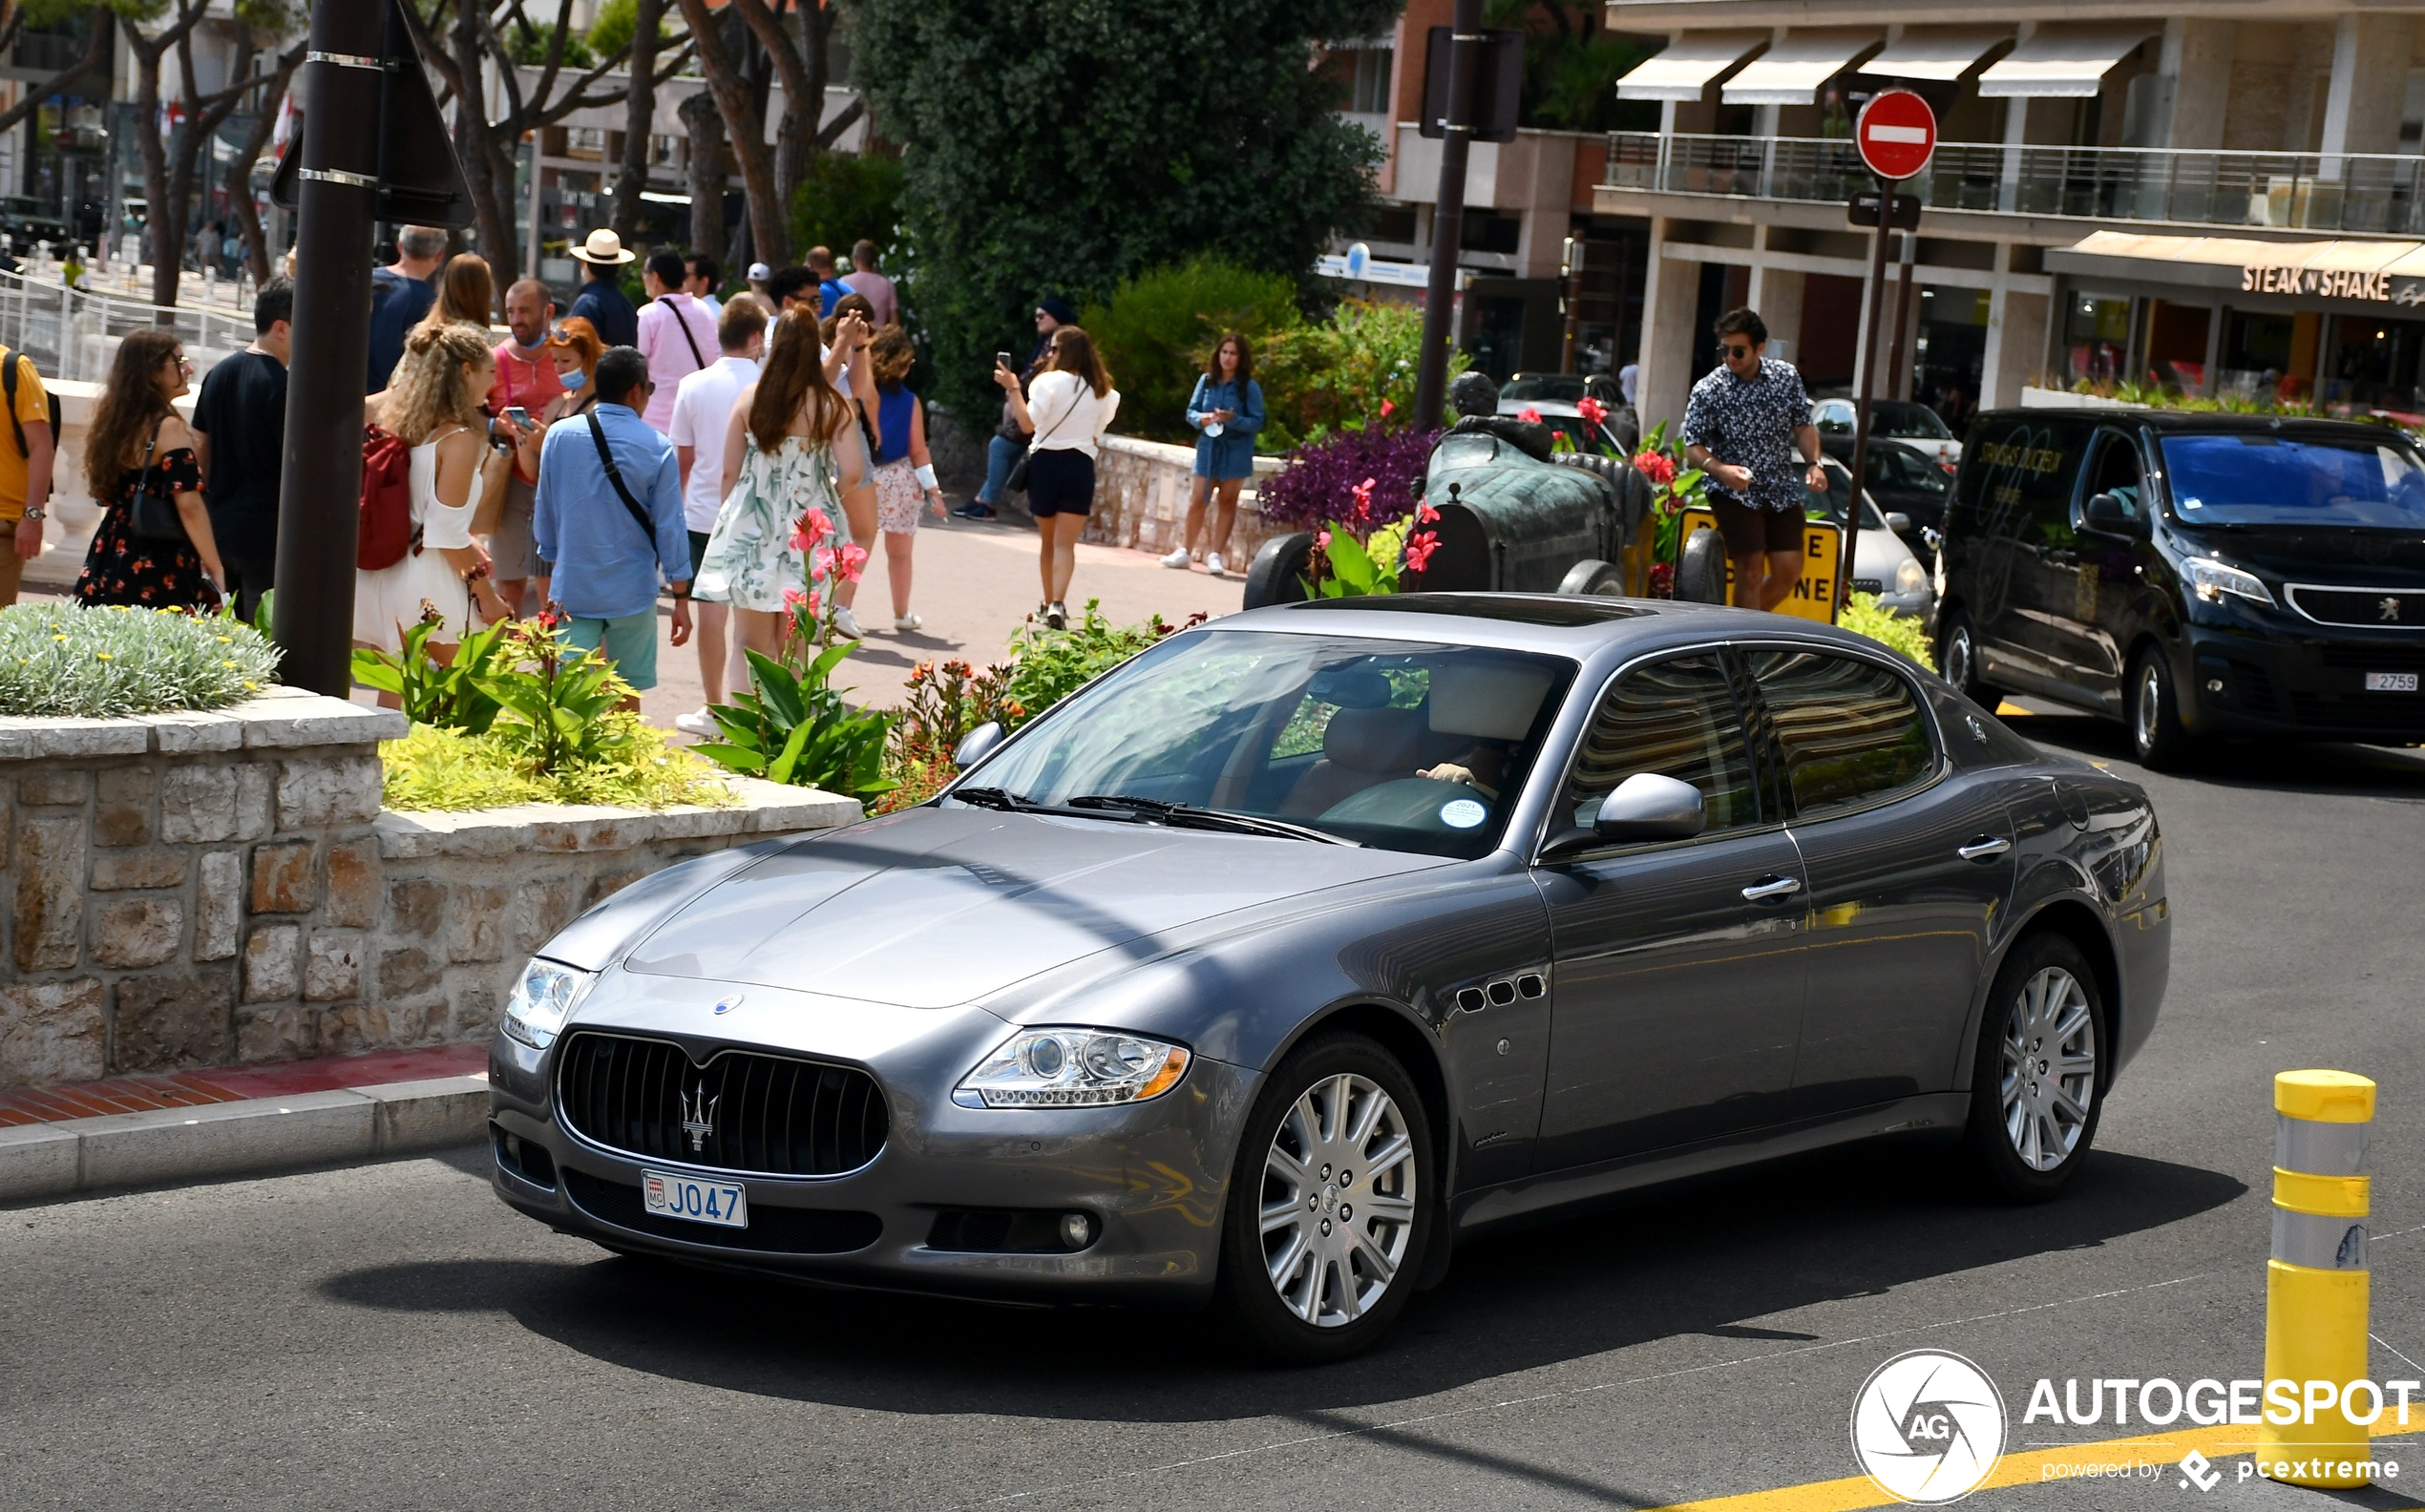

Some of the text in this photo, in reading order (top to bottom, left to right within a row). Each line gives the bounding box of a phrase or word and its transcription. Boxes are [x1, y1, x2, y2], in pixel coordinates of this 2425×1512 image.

[2242, 262, 2305, 294] STEAK
[2305, 271, 2318, 291] N
[2319, 269, 2392, 302] SHAKE
[2379, 675, 2415, 689] 2759
[649, 1192, 664, 1203] MC
